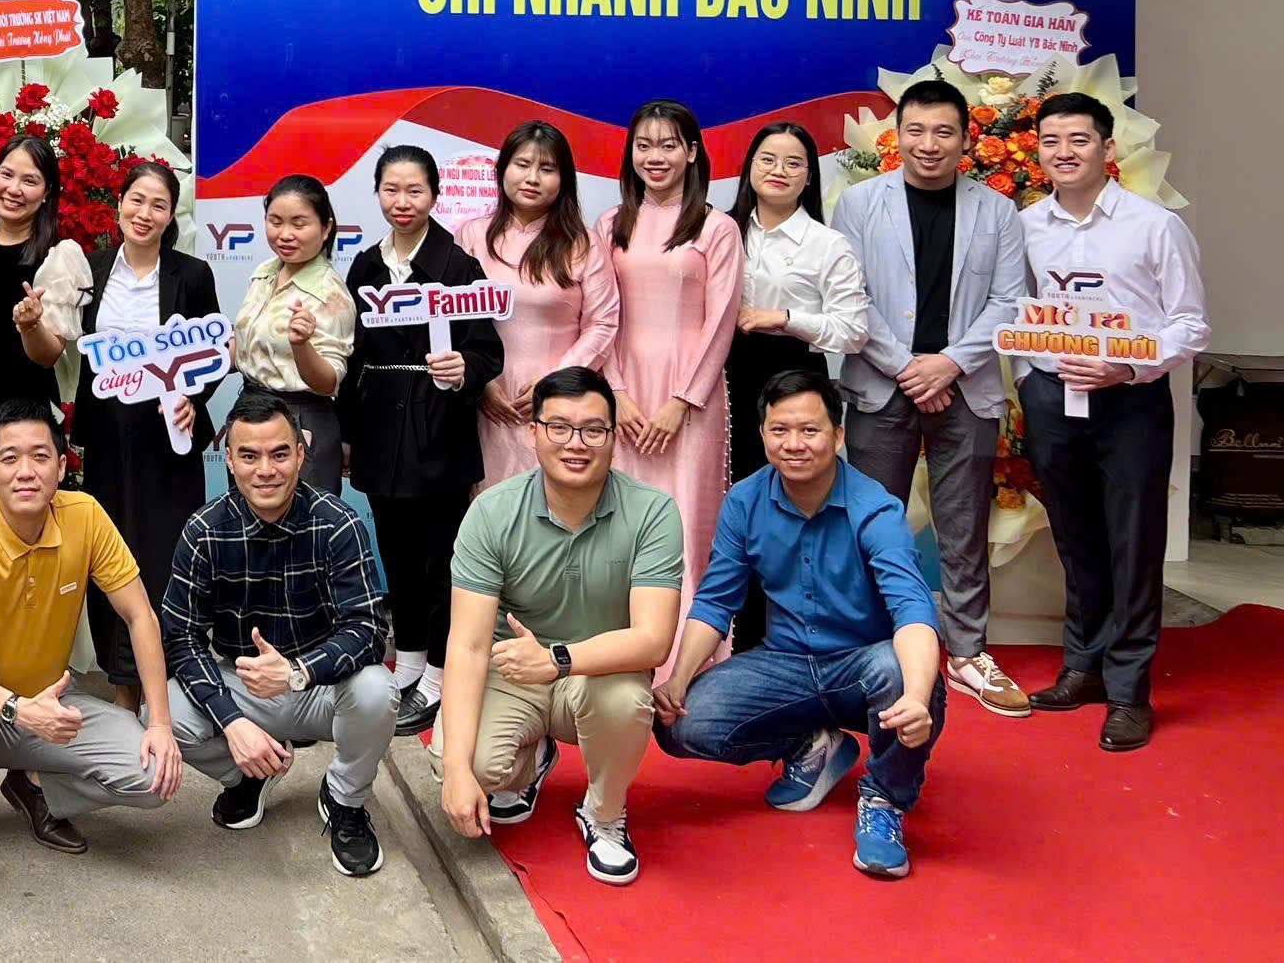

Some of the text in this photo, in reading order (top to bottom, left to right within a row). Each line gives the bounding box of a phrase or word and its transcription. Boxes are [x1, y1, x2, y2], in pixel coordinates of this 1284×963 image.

[986, 8, 1021, 26] TOÁN
[1023, 15, 1044, 29] GIA
[974, 31, 995, 46] Công
[998, 33, 1006, 47] Ty
[1059, 40, 1078, 54] Ninh
[206, 223, 254, 250] YP
[428, 286, 509, 317] Family
[1022, 301, 1132, 331] Mở ra
[84, 336, 145, 366] Tỏa
[997, 329, 1157, 360] CHƯƠNG MỚI
[99, 369, 144, 397] cùng
